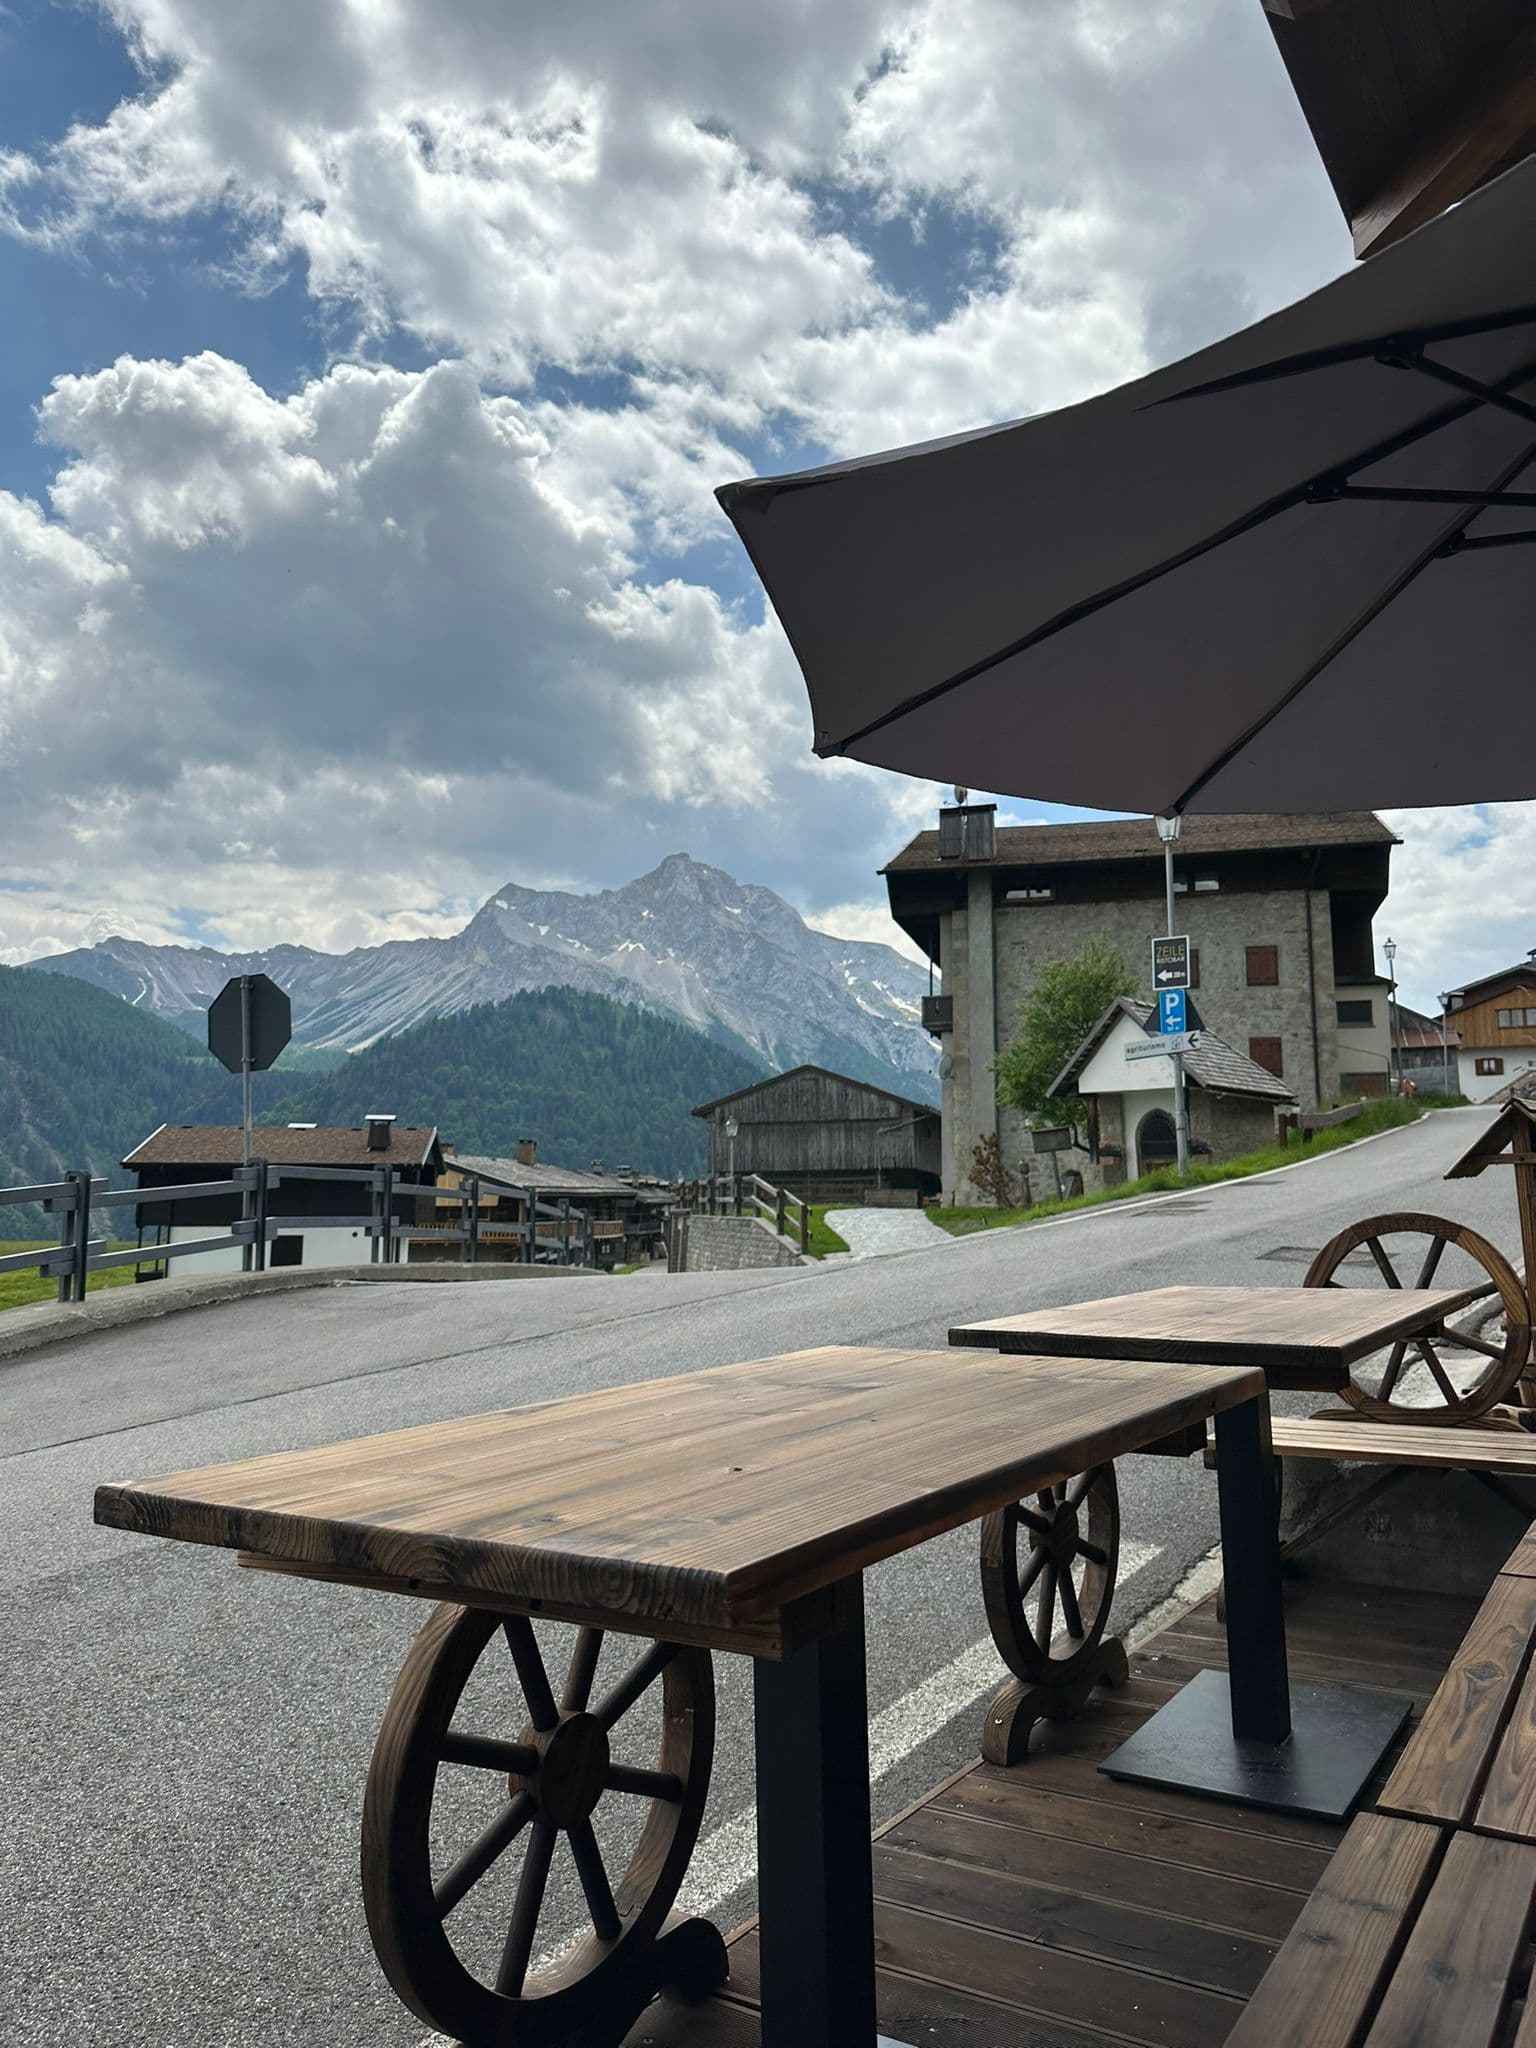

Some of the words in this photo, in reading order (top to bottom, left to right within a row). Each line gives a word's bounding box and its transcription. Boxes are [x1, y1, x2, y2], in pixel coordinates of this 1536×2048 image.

[1156, 945, 1185, 957] ZEILE
[1156, 956, 1185, 964] RISTOBAR
[1165, 993, 1179, 1015] P
[1126, 1042, 1166, 1055] agriturismo
